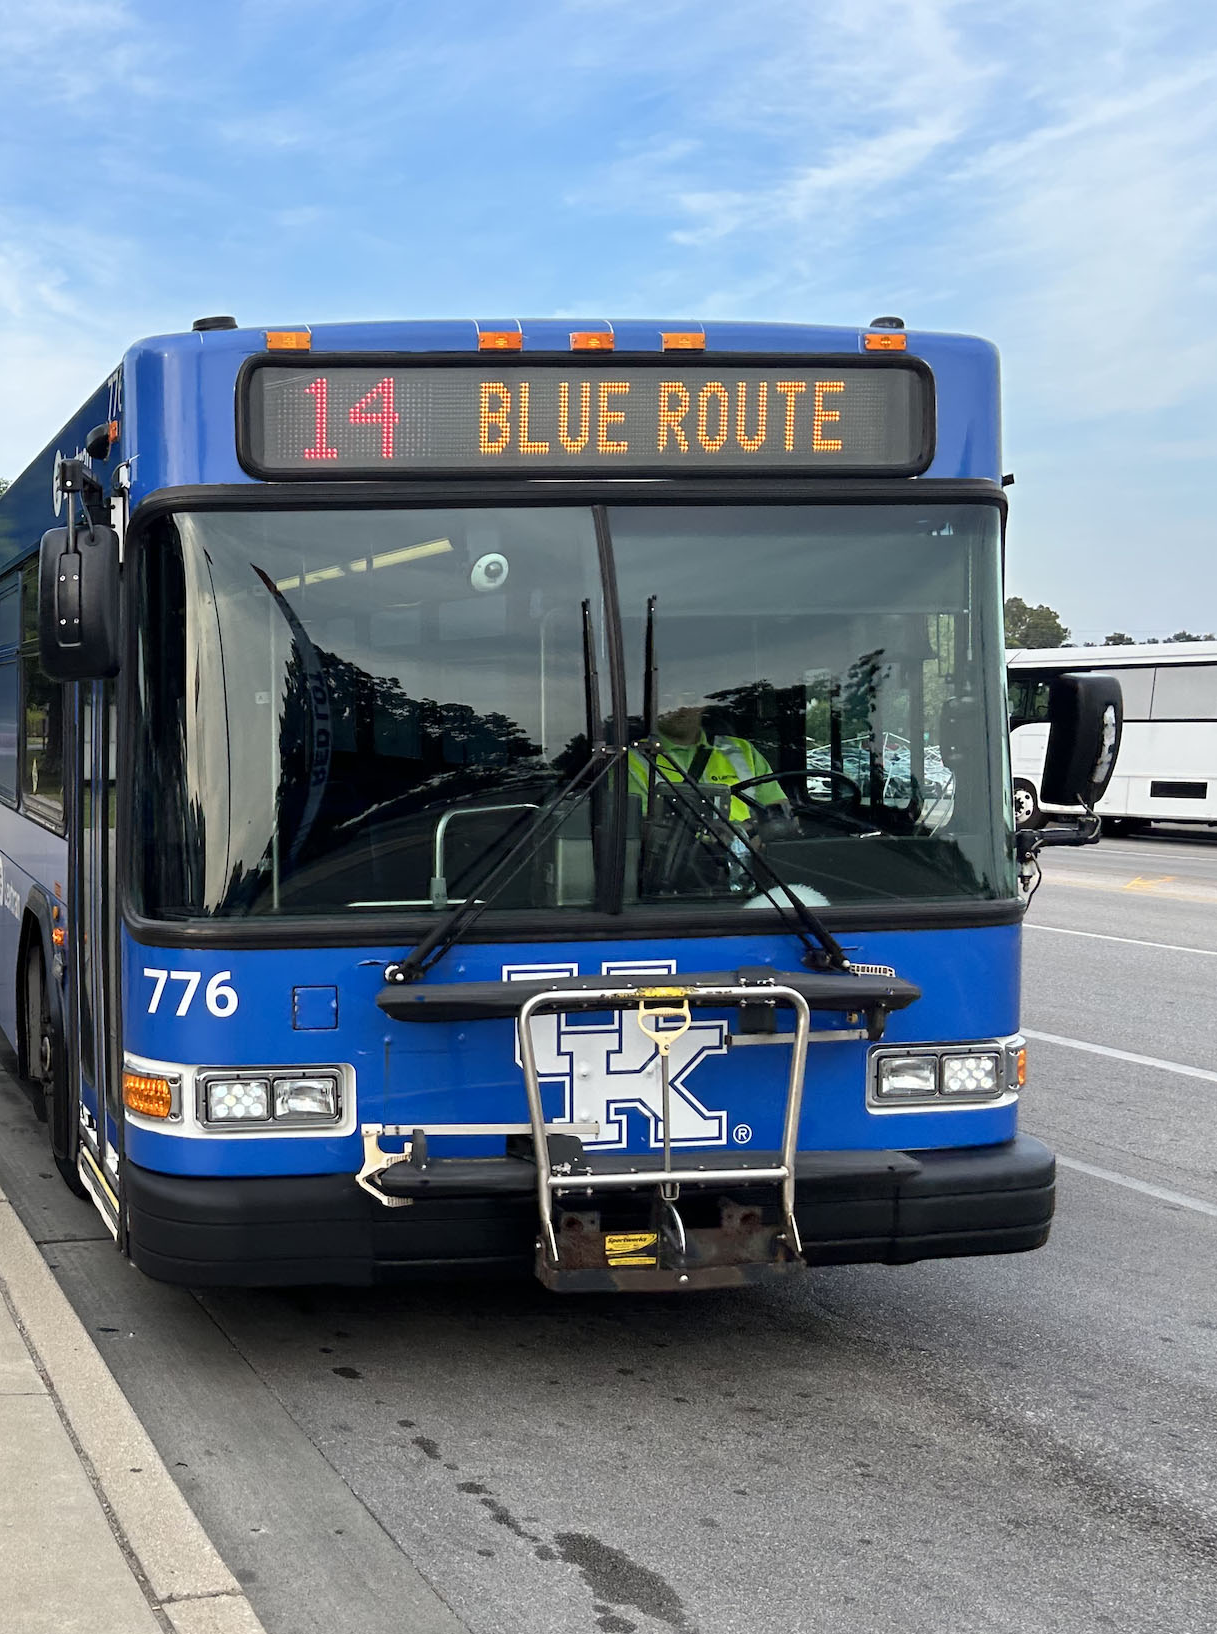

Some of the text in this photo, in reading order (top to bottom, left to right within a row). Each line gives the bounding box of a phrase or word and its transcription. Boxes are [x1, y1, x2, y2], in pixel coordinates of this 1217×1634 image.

[304, 378, 845, 459] 14 BLUE ROUTE
[143, 967, 239, 1018] 776
